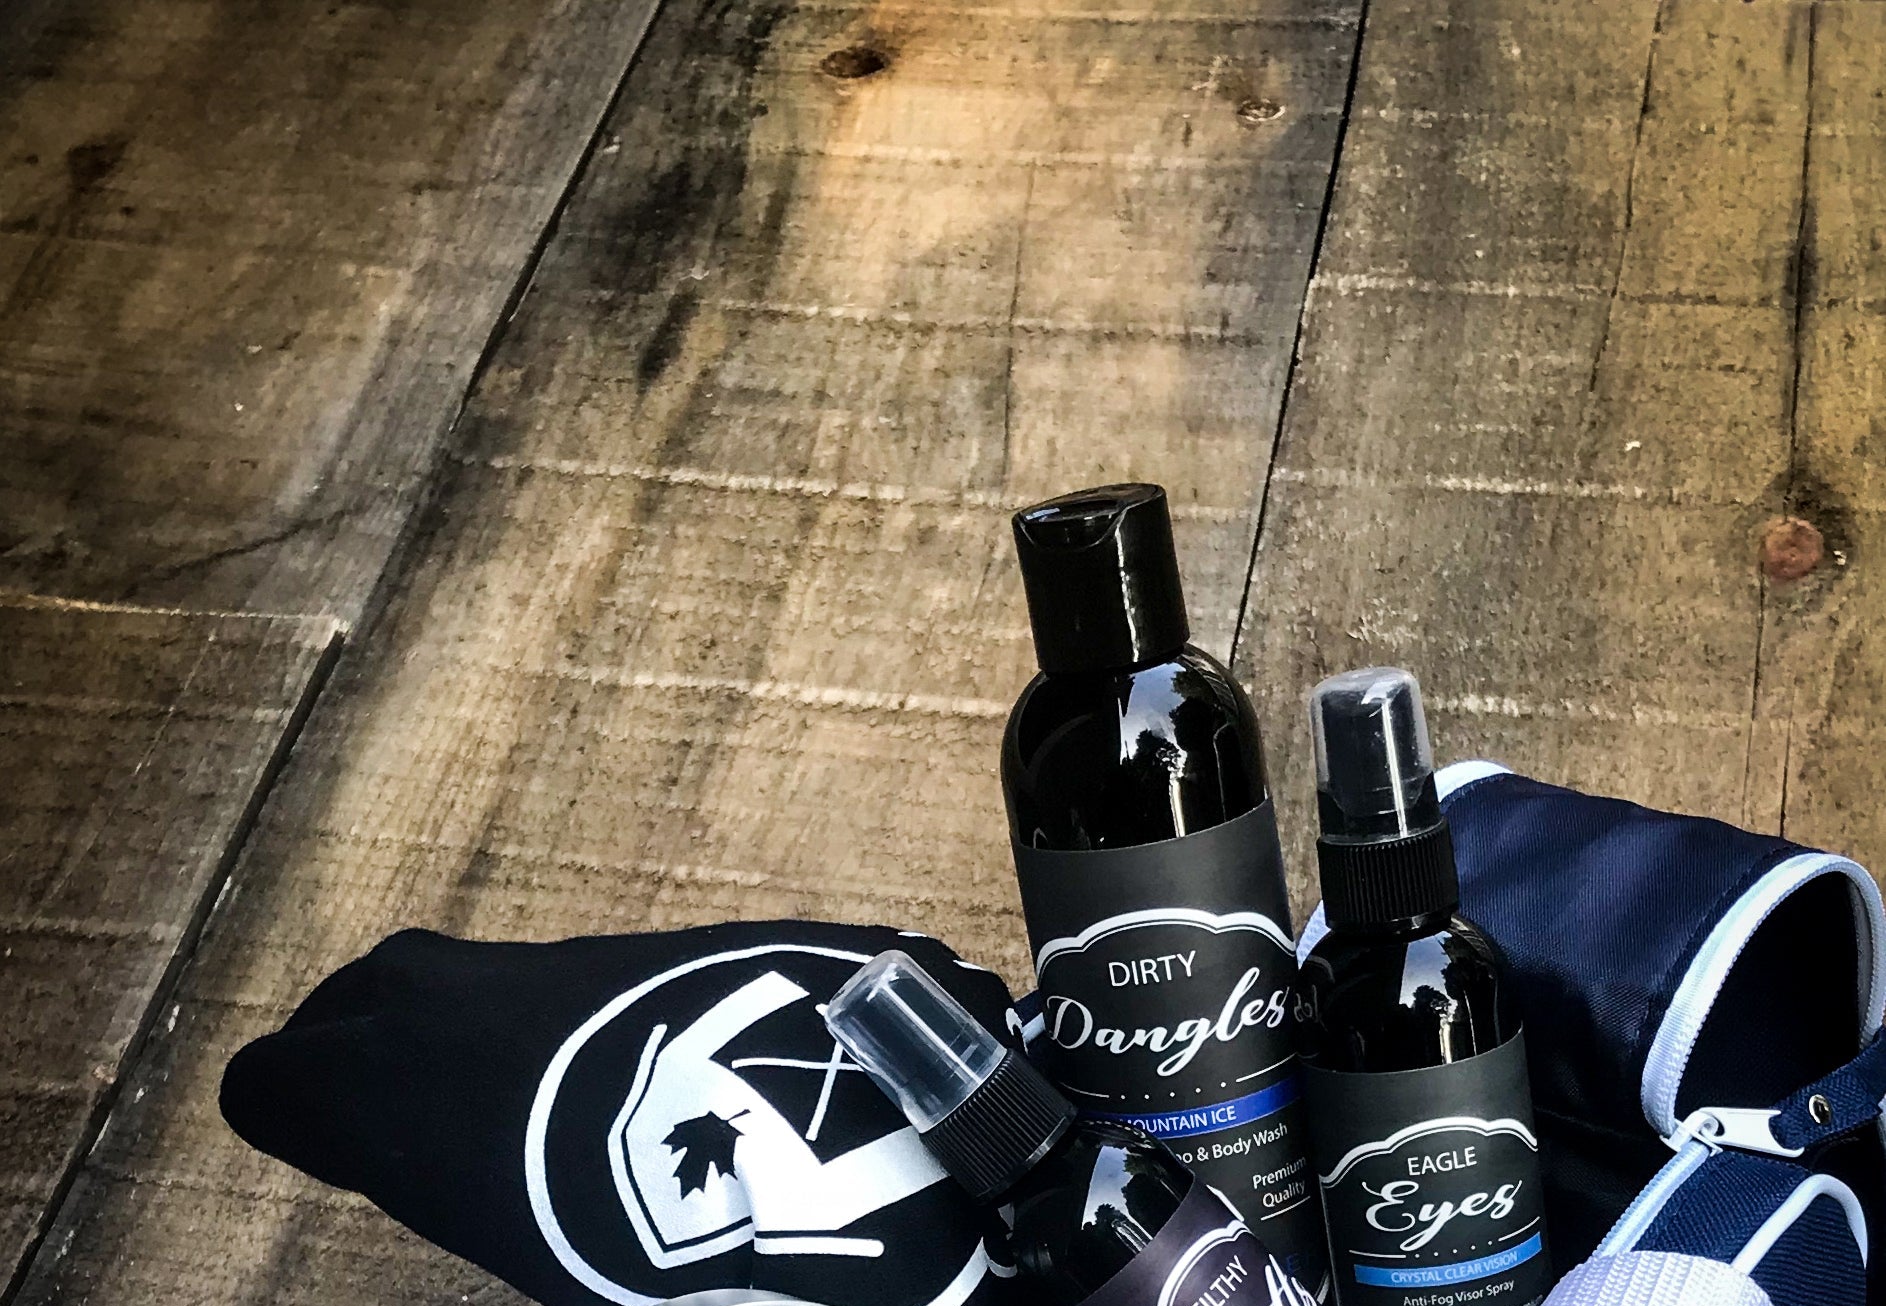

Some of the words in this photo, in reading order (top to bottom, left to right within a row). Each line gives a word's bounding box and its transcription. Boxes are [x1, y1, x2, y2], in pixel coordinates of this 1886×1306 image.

[1108, 949, 1197, 988] DIRTY
[1045, 966, 1291, 1077] Dangles
[1126, 1110, 1208, 1135] OUNTAIN
[1209, 1106, 1237, 1127] ICE
[1196, 1147, 1210, 1162] &
[1212, 1138, 1252, 1159] Body
[1253, 1122, 1288, 1147] Wash
[1252, 1156, 1307, 1189] Premium
[1407, 1146, 1477, 1176] EAGLE
[1263, 1180, 1306, 1207] Quality
[1361, 1179, 1523, 1252] Eyes
[1391, 1270, 1442, 1284] CRYSTAL
[1444, 1264, 1482, 1280] CLEAR
[1483, 1251, 1518, 1271] VISION
[1403, 1294, 1454, 1306] Anti-Fog
[1455, 1289, 1484, 1302] Visor
[1486, 1279, 1515, 1296] Spray
